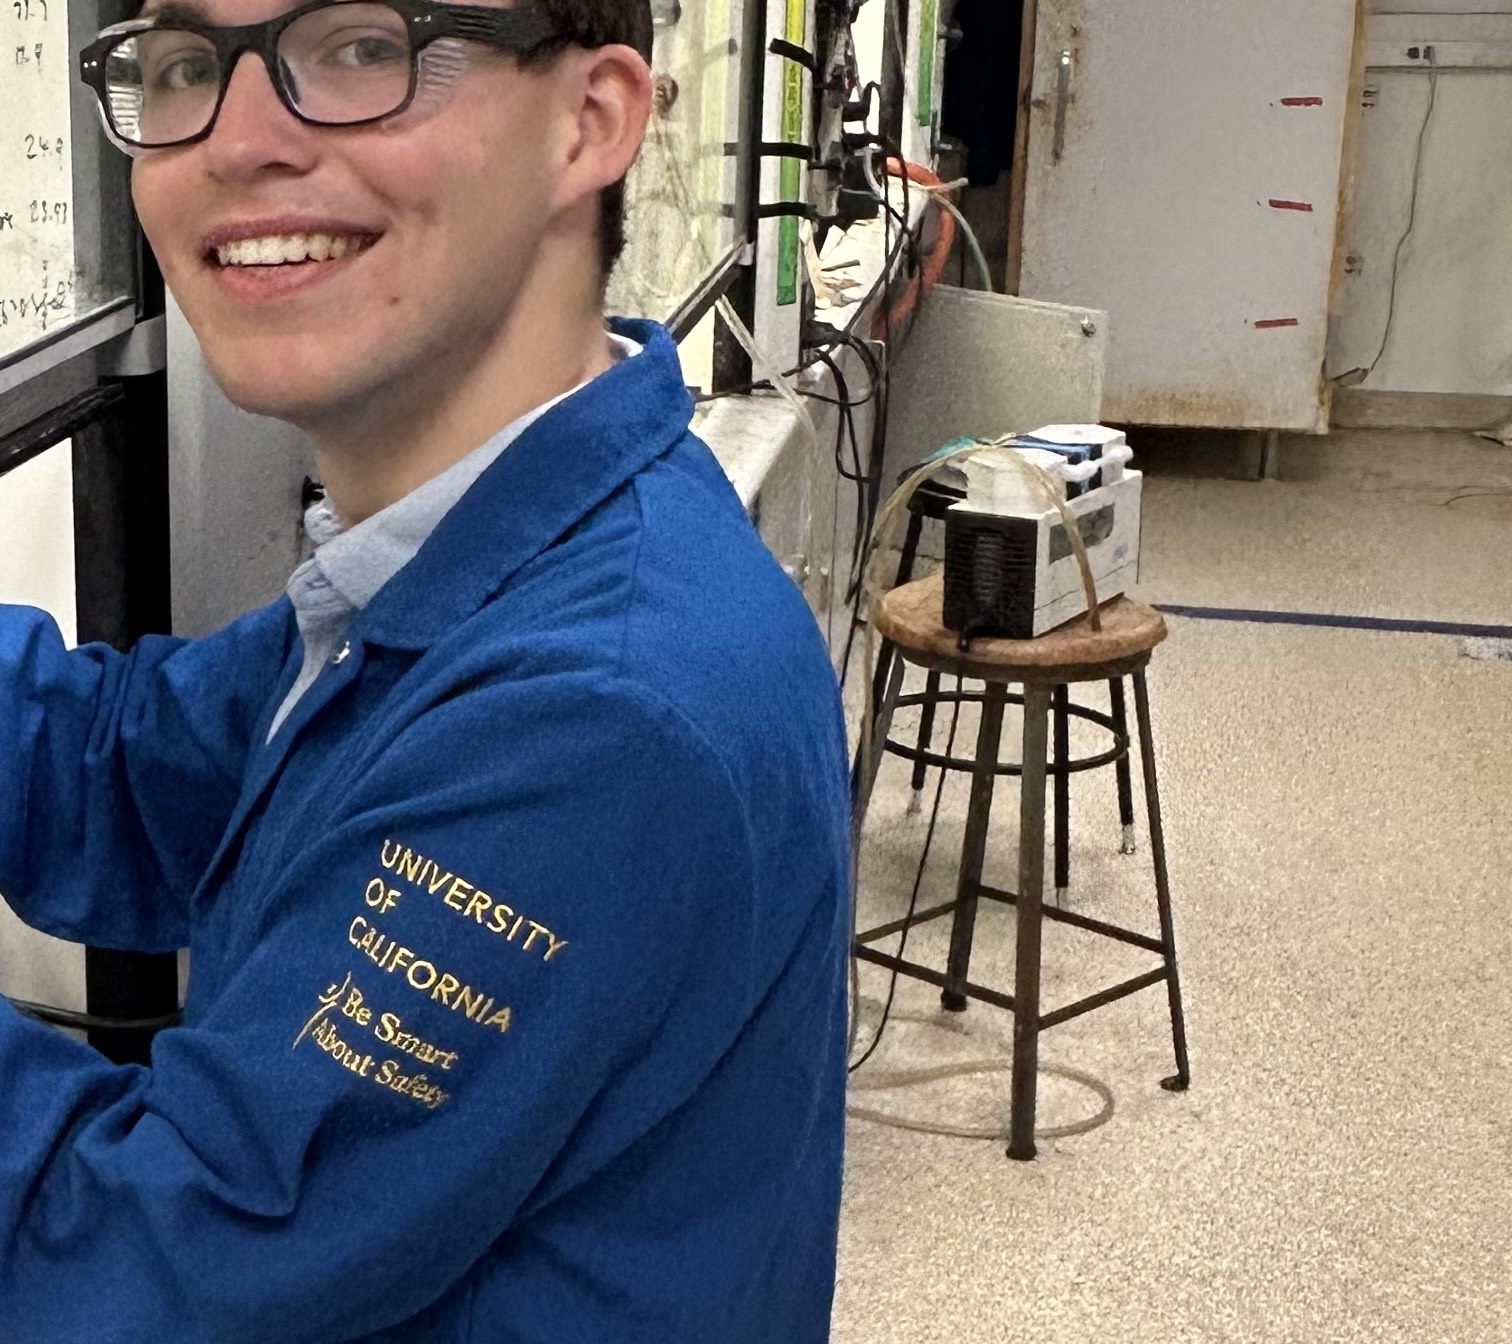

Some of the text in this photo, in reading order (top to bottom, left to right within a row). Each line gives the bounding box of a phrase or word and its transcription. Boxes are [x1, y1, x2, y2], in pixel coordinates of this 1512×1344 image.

[365, 877, 402, 914] OF
[380, 839, 569, 962] UNIVERSITY
[348, 915, 513, 1033] CALIFORNIA
[312, 1017, 452, 1110] About Safety
[341, 987, 459, 1070] Be Smart
